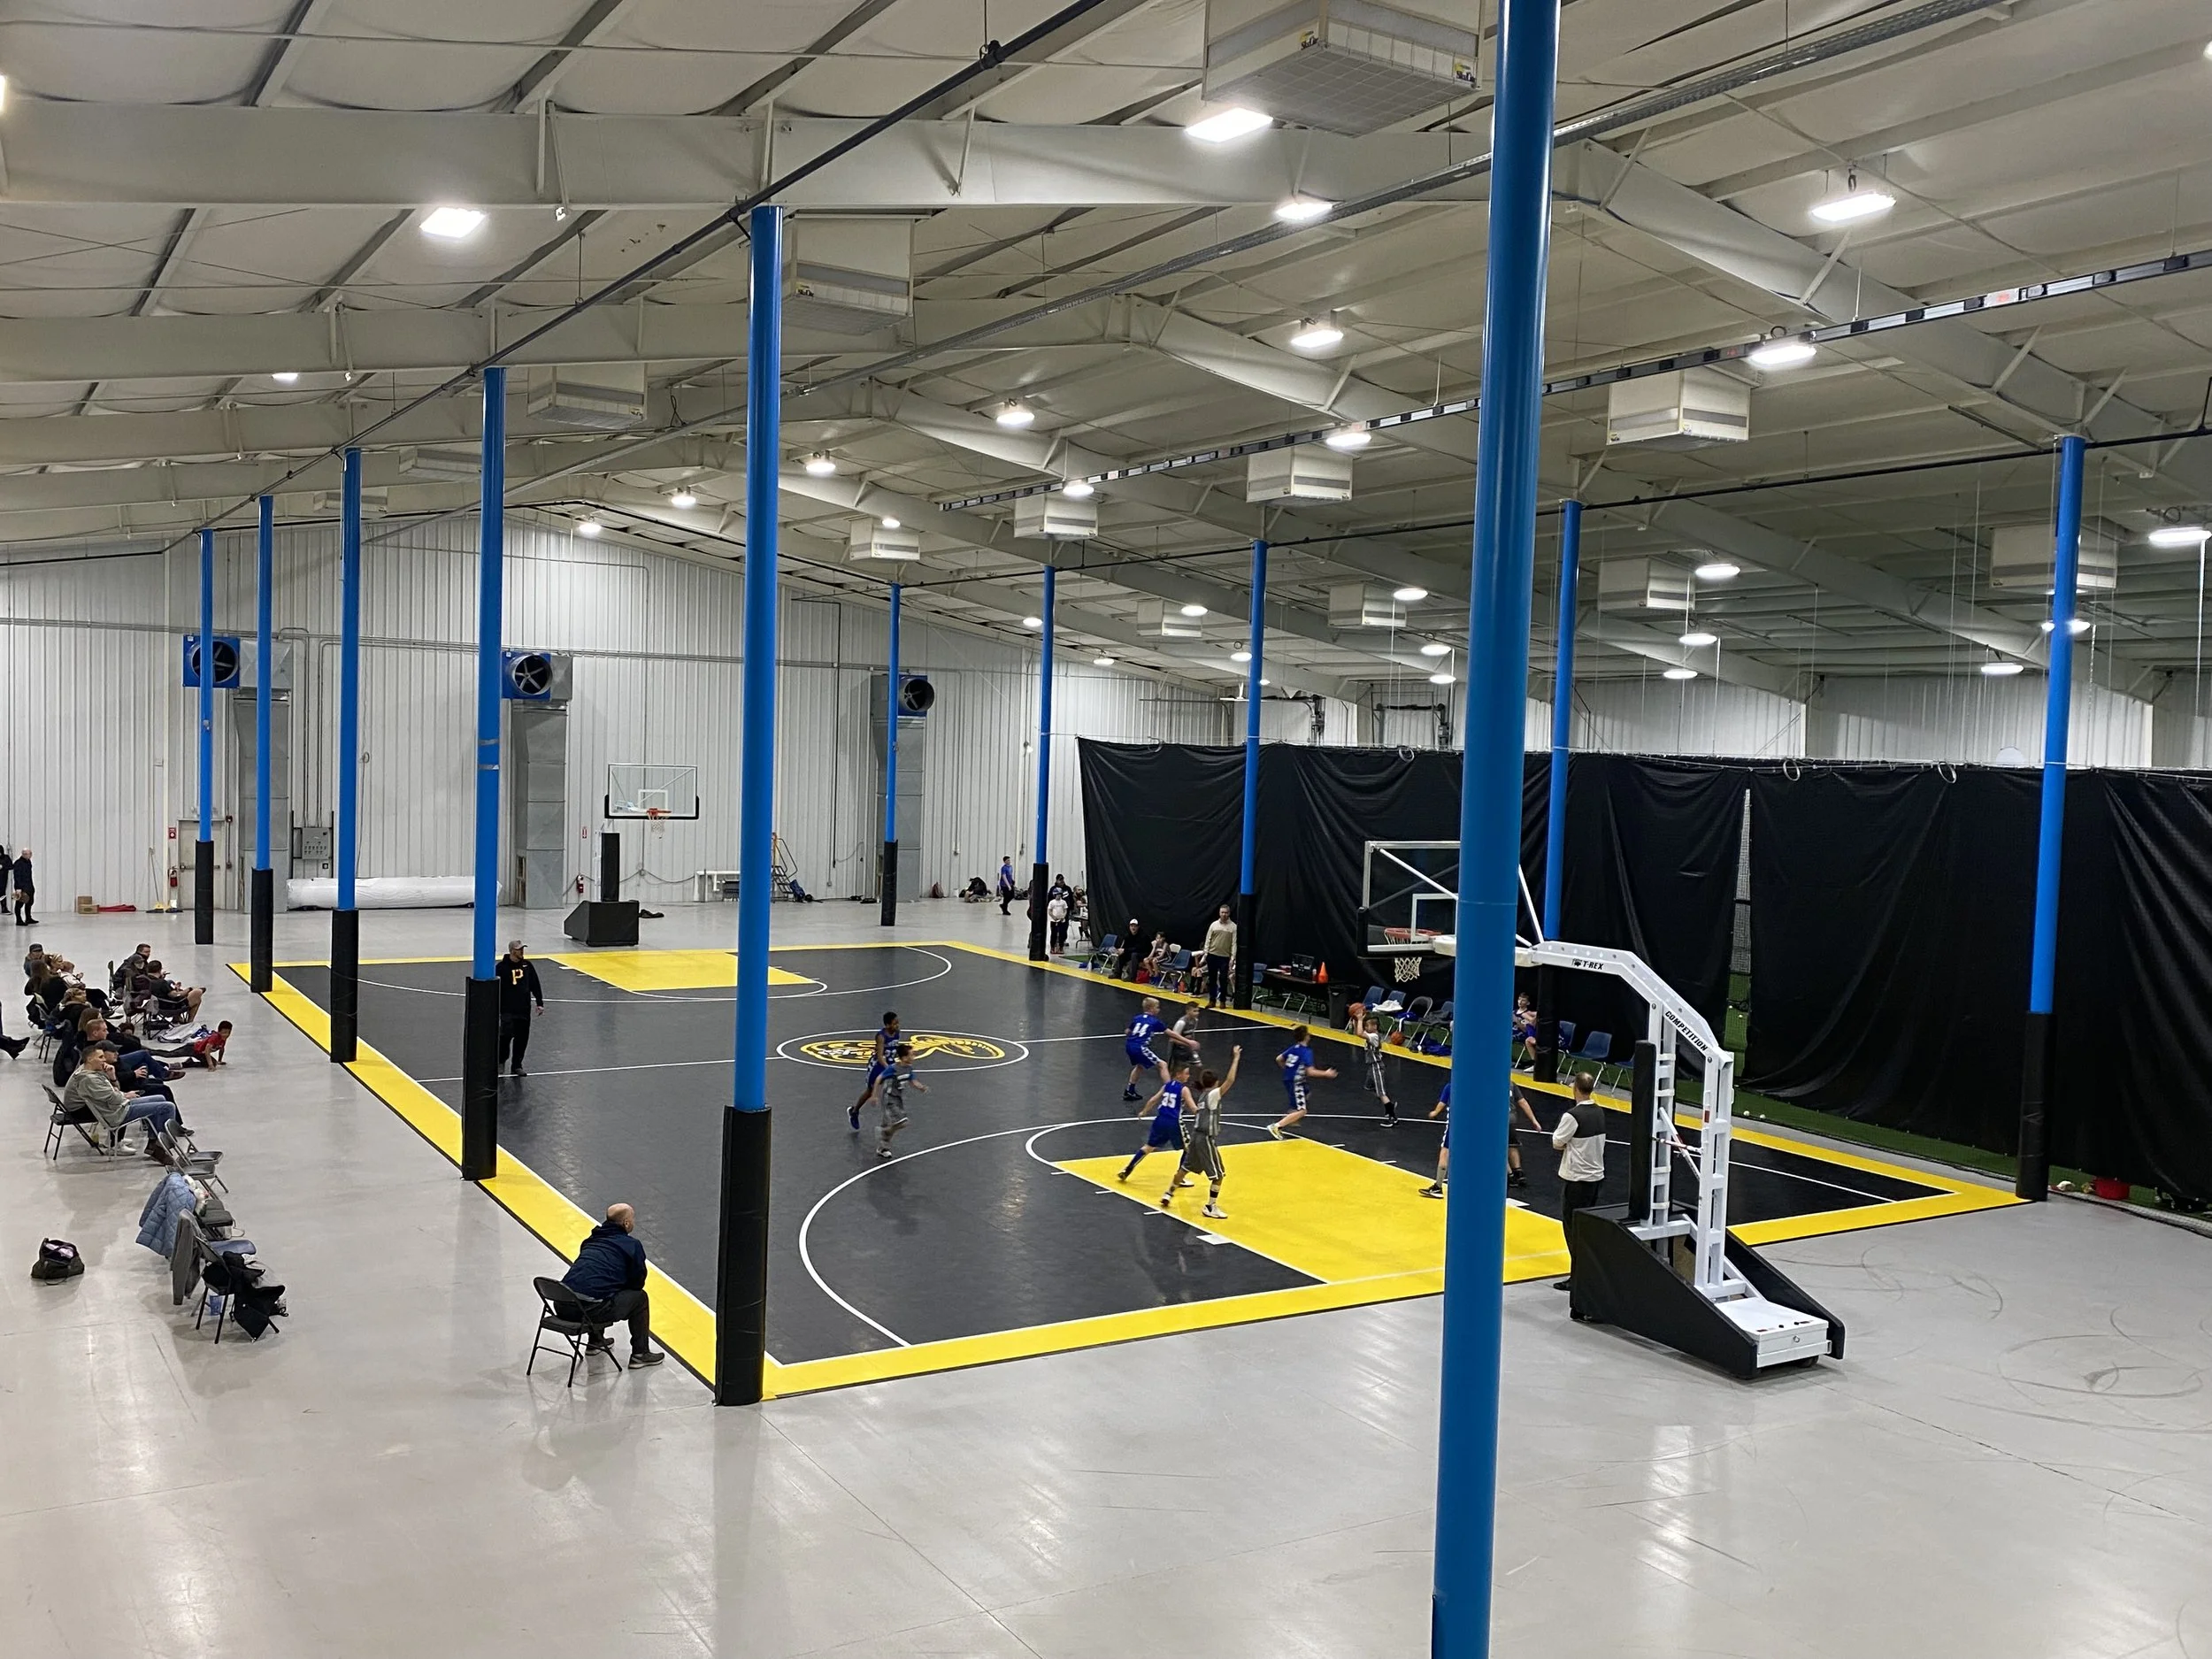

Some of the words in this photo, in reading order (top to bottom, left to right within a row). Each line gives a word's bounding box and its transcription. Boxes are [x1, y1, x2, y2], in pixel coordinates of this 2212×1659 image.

[1583, 960, 1604, 971] T-REX
[511, 969, 524, 985] P
[1664, 1010, 1709, 1052] COMPETITION
